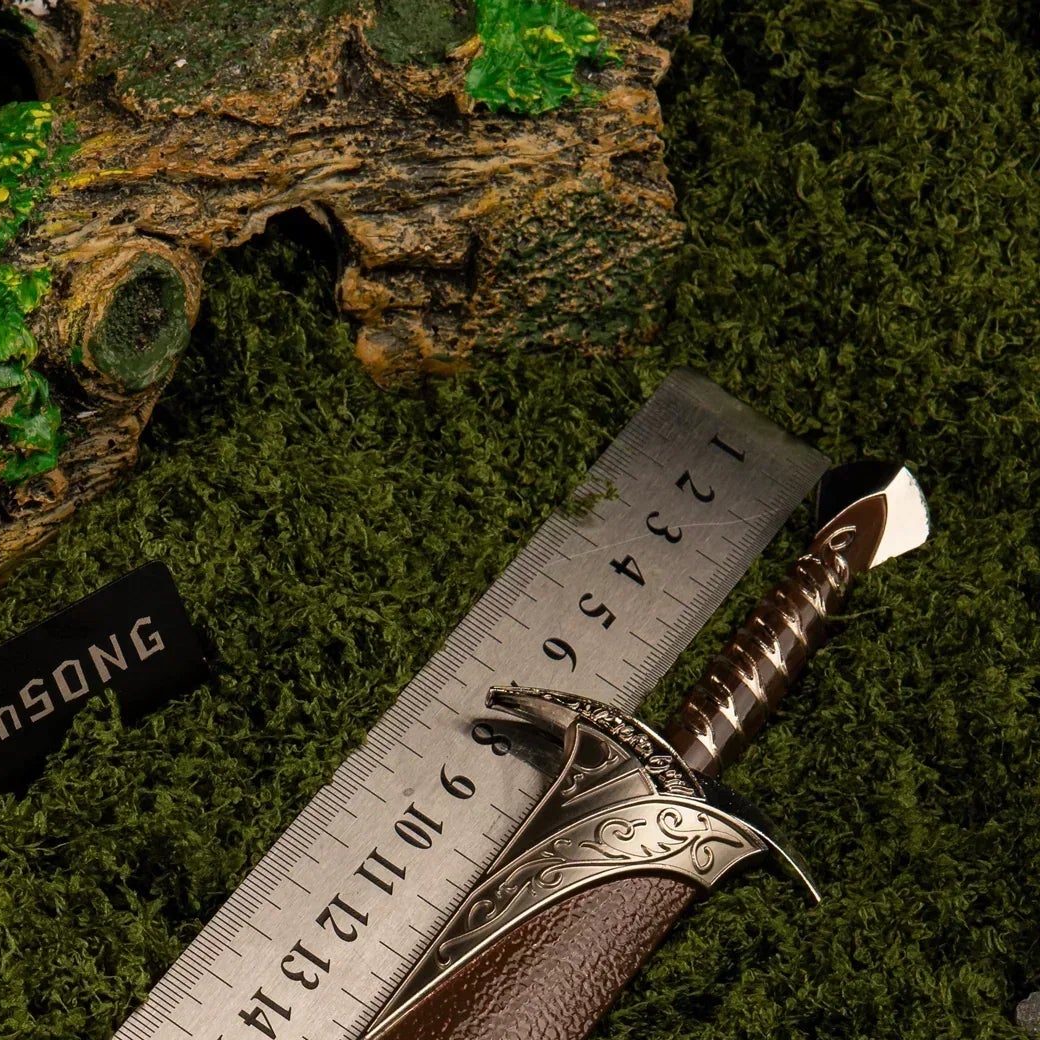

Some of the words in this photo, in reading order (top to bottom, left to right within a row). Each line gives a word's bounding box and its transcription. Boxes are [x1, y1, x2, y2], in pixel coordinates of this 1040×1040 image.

[710, 434, 746, 463] 1
[676, 470, 716, 503] 2
[646, 512, 683, 543] 3
[610, 554, 646, 586] 4
[579, 593, 616, 630] 5
[543, 637, 578, 673] 6
[471, 723, 512, 756] 8
[441, 763, 476, 800] 9
[394, 802, 444, 850] 10
[354, 847, 406, 895] 11
[316, 893, 369, 942] 12
[281, 939, 331, 990] 13
[238, 987, 292, 1040] 14
